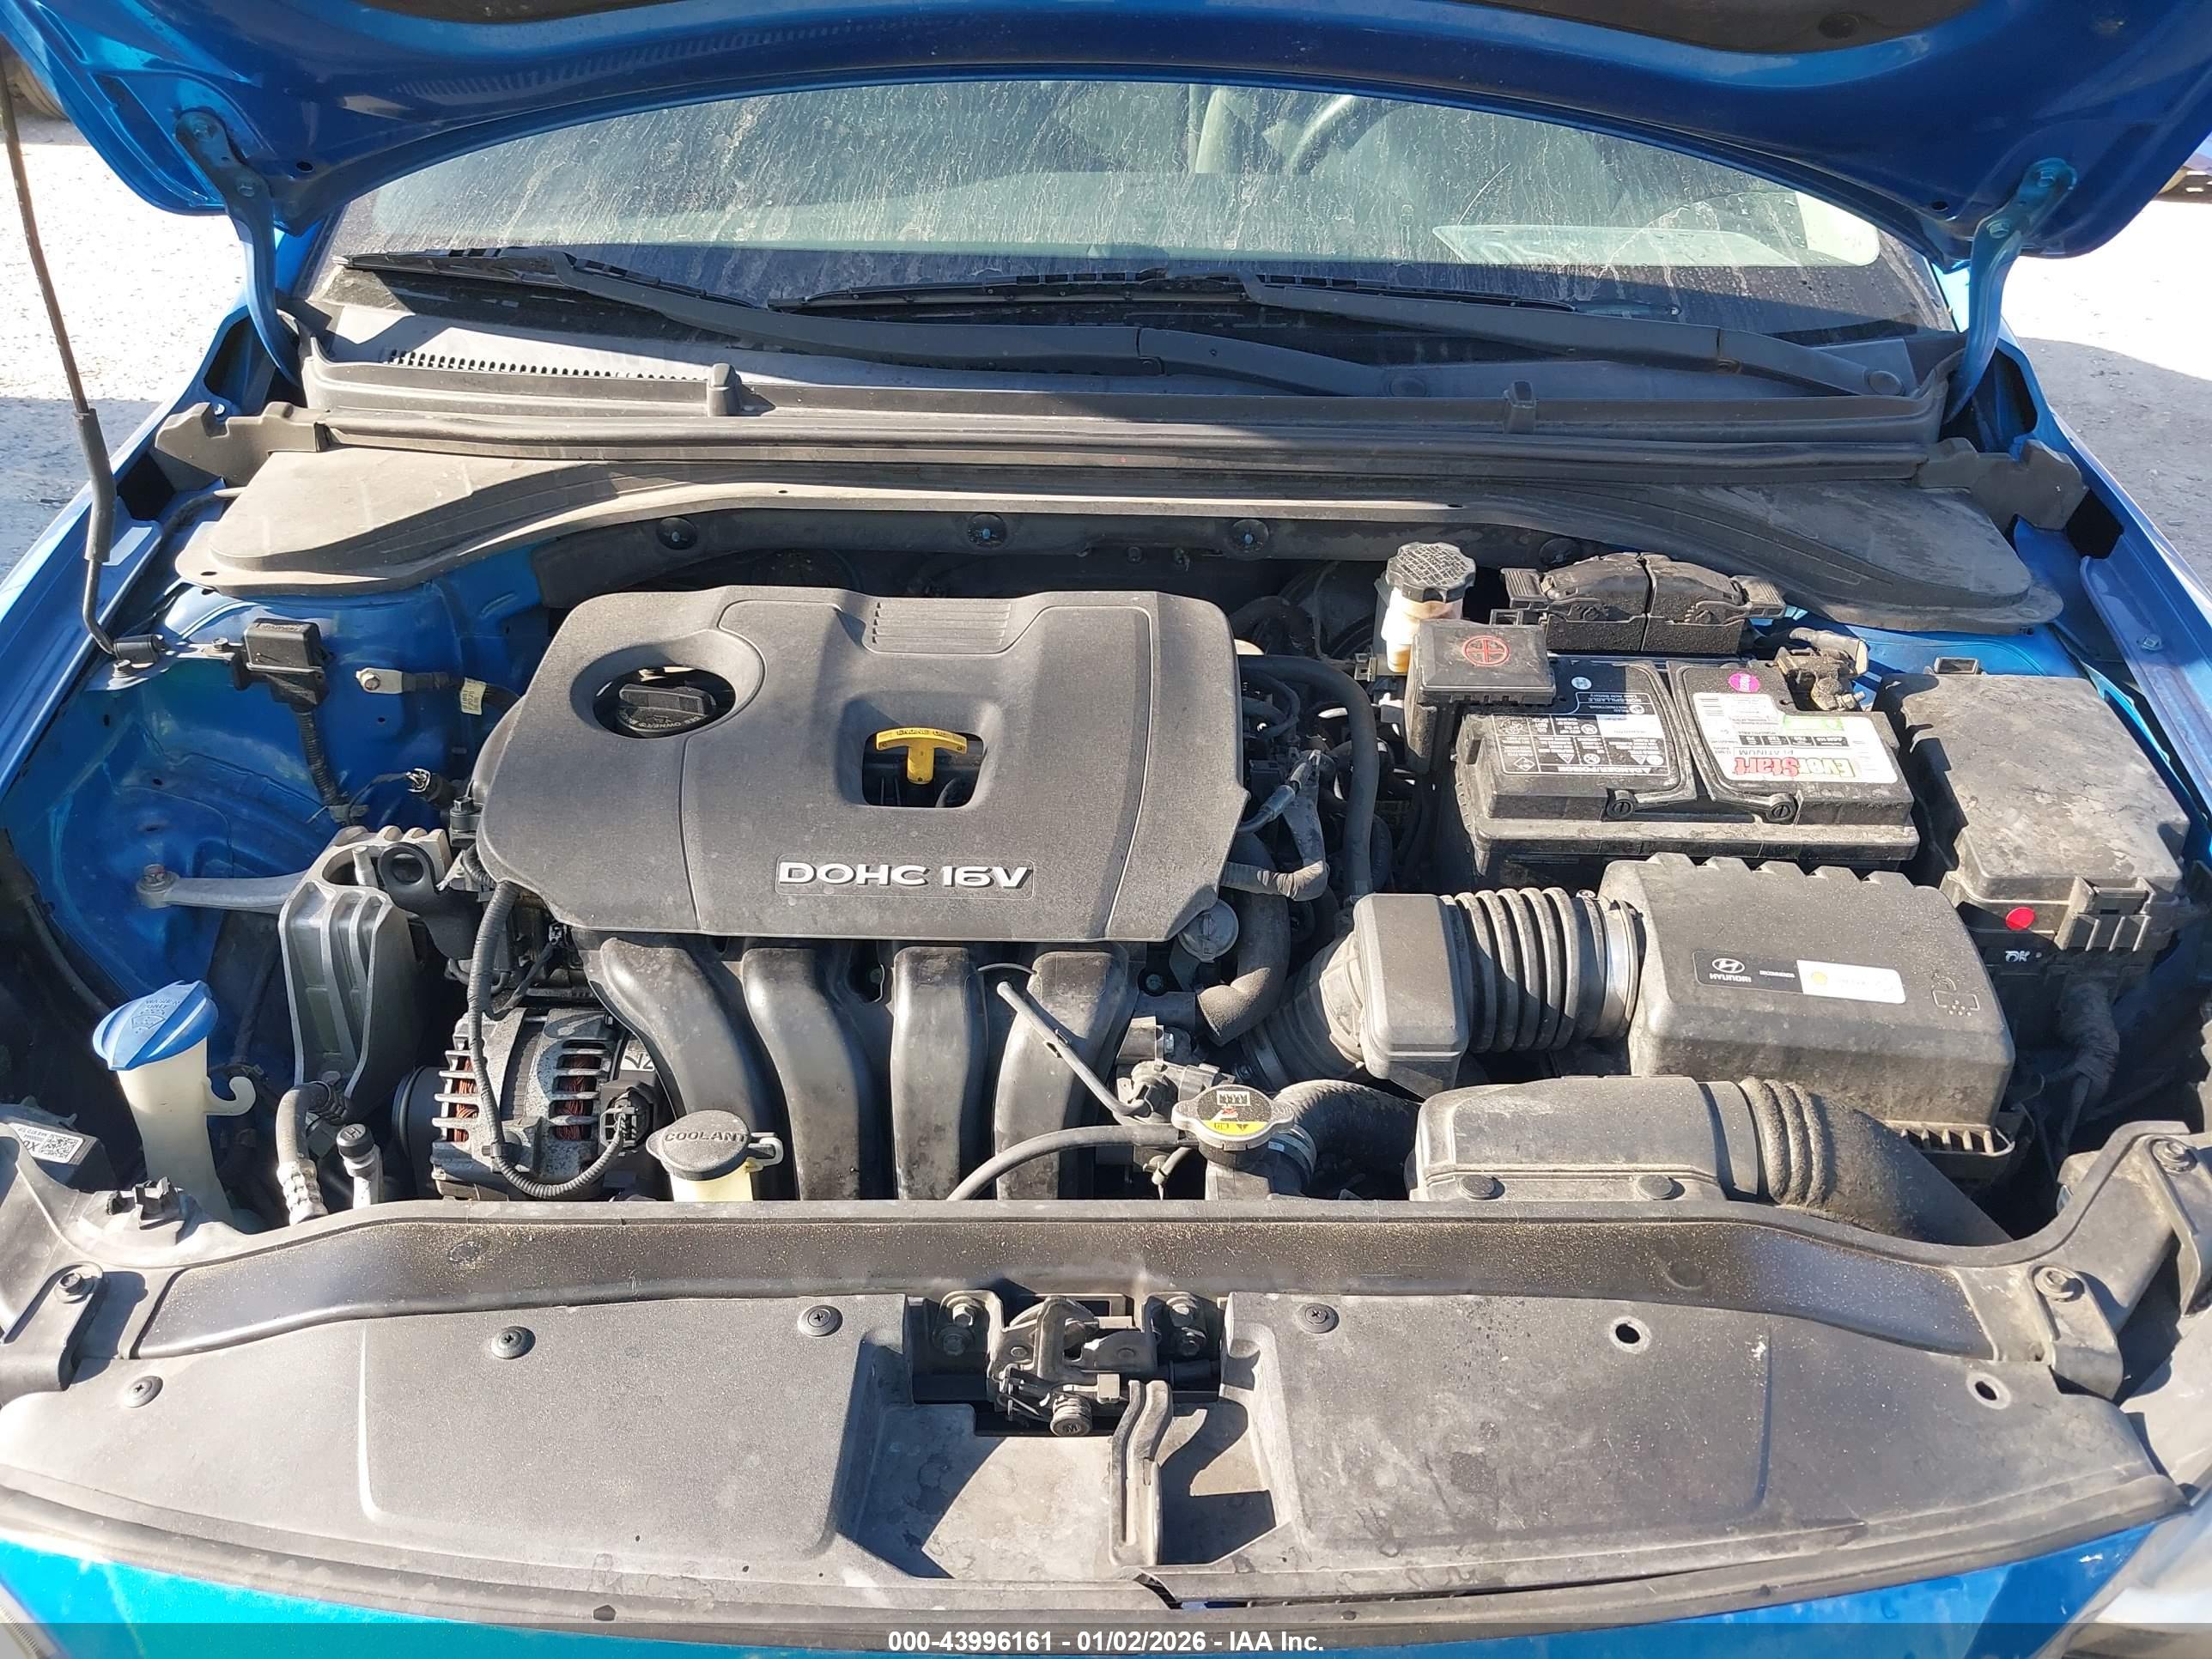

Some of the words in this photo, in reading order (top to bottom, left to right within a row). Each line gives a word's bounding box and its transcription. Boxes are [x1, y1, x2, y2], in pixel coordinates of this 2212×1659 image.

[1735, 757, 1856, 777] EverStart
[779, 862, 932, 886] DOHC
[940, 865, 1032, 889] 16V
[1709, 973, 1752, 983] HYUNDAI
[664, 1132, 746, 1143] COOLANT
